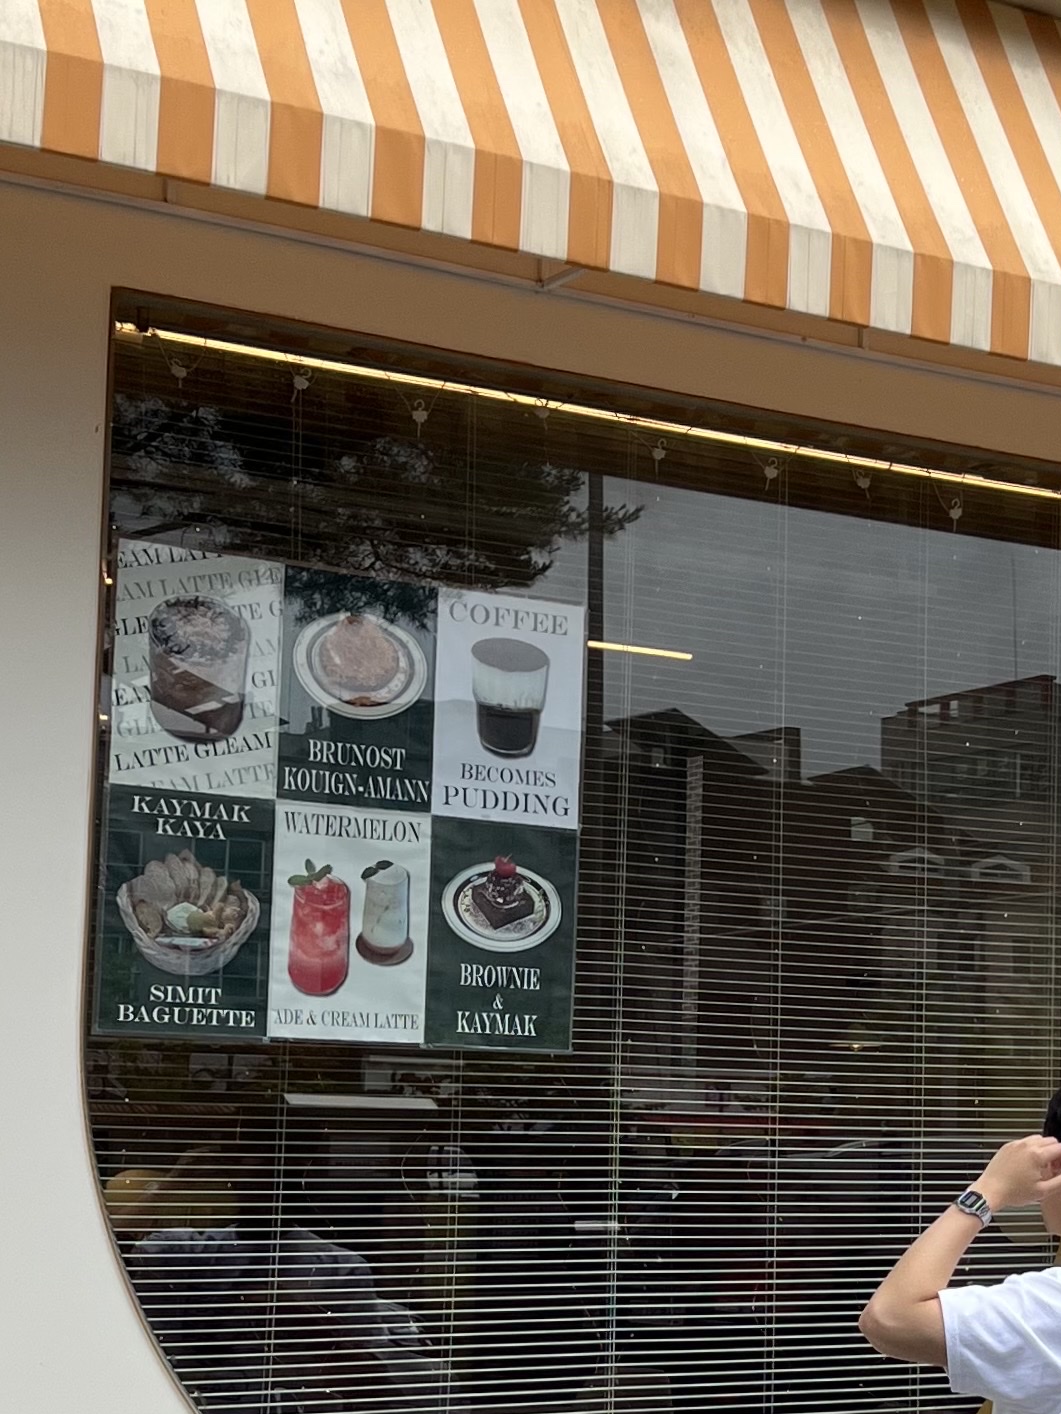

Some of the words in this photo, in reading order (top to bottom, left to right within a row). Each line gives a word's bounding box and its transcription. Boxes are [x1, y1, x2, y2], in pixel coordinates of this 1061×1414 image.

[158, 571, 233, 598] LATTE
[450, 600, 569, 636] COFFEE
[114, 743, 189, 772] LATTE
[194, 731, 273, 760] GLEAM
[308, 739, 406, 770] BRUNOST
[283, 767, 431, 803] KOUIGN-AMANN
[460, 762, 557, 788] BECOMES
[131, 795, 252, 823] KAYMAK
[442, 785, 570, 817] PUDDING
[155, 817, 227, 841] KAYA
[284, 811, 422, 843] WATERMELON
[459, 963, 541, 990] BROWNIE
[149, 984, 222, 1005] SIMIT
[492, 993, 504, 1010] &
[117, 1004, 256, 1027] BAGUETTE
[274, 1008, 304, 1025] ADE
[306, 1010, 317, 1026] &
[321, 1009, 371, 1028] CREAM
[374, 1012, 420, 1030] LATTE
[456, 1010, 538, 1037] KAYMAK
